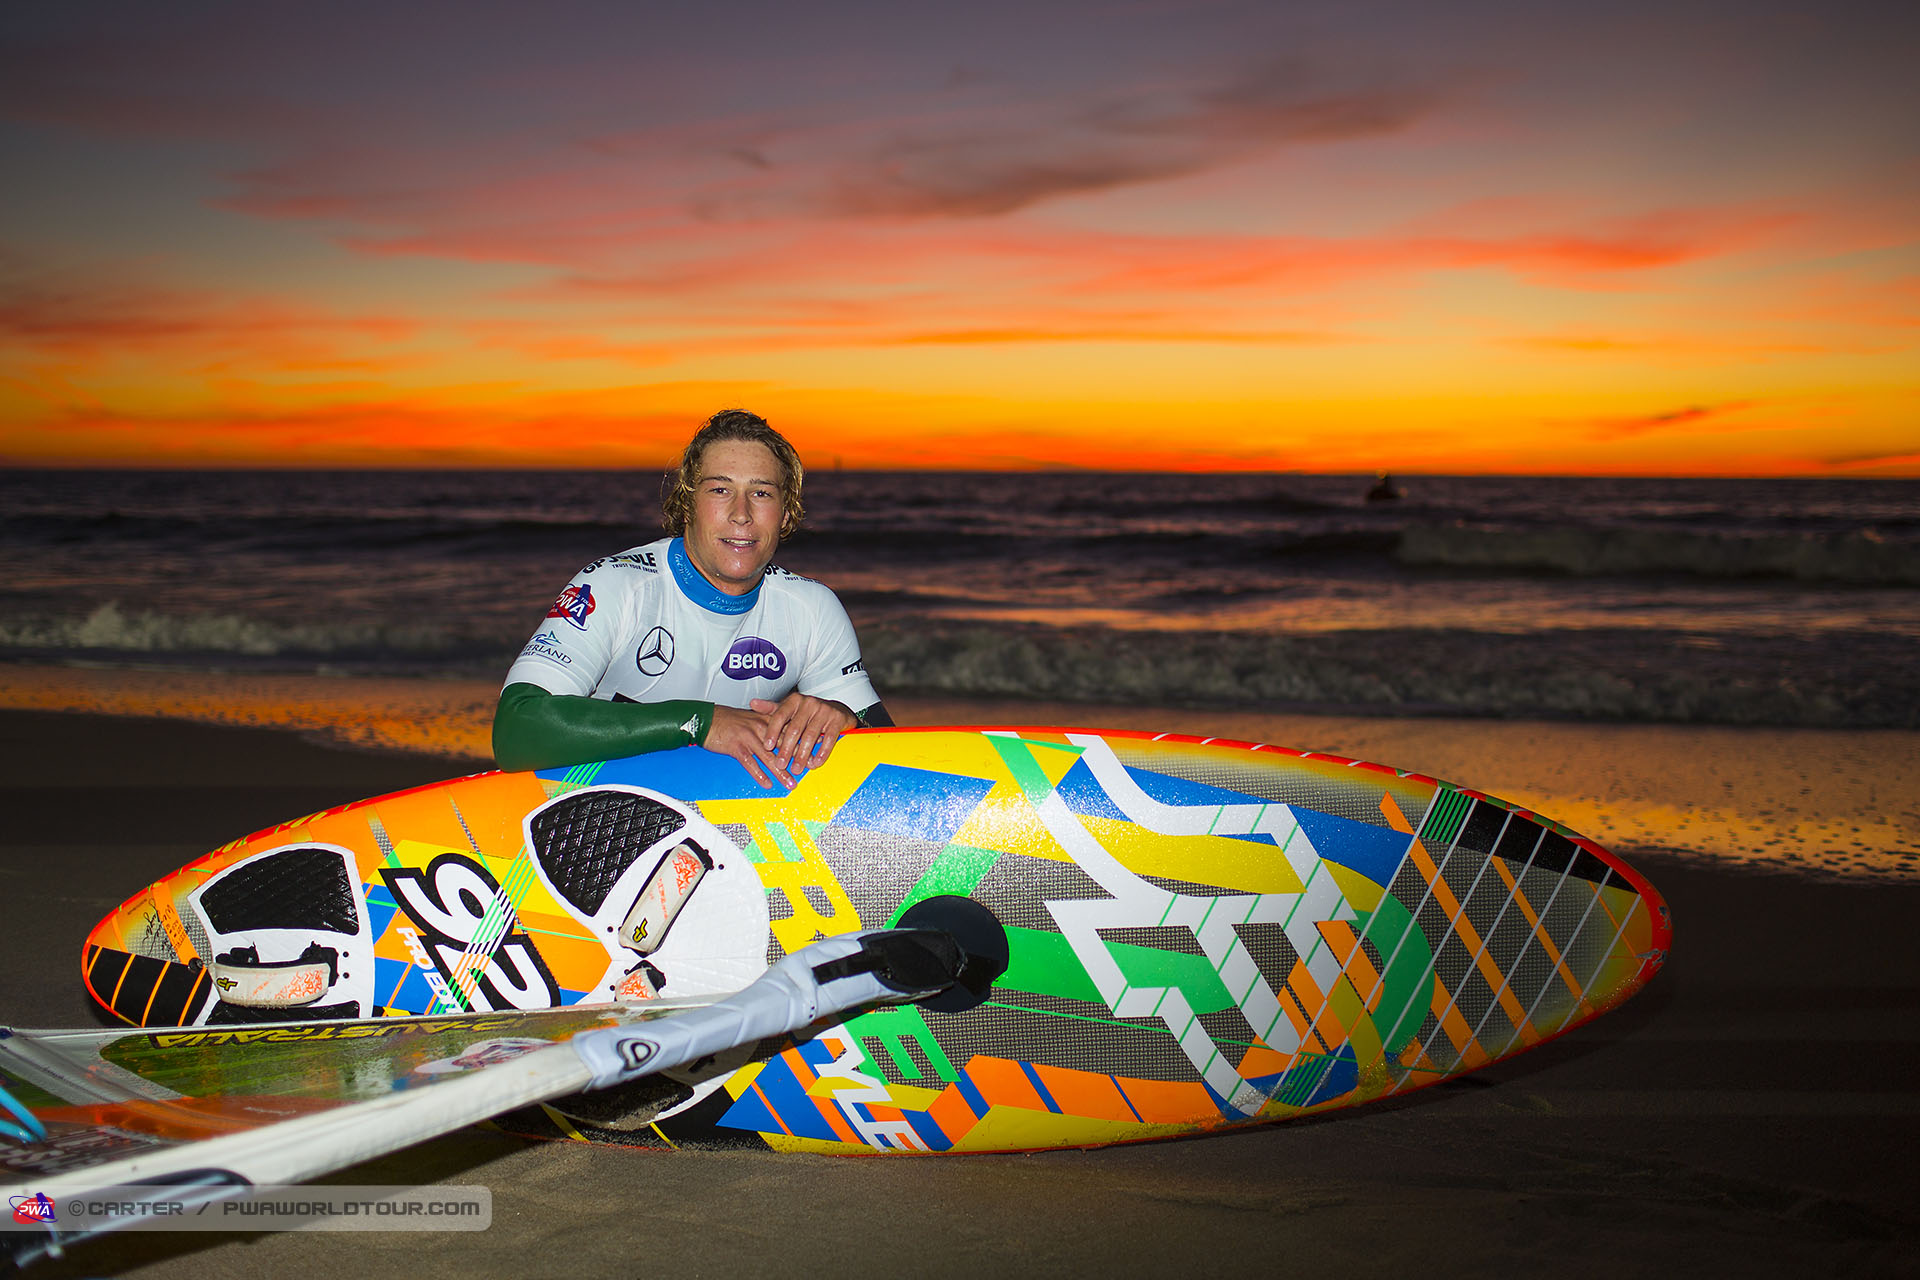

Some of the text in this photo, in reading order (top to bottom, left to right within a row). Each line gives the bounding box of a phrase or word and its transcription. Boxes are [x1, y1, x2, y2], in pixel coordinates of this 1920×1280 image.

[728, 652, 781, 672] BenQ
[383, 856, 558, 1013] 92
[396, 927, 436, 971] PRO
